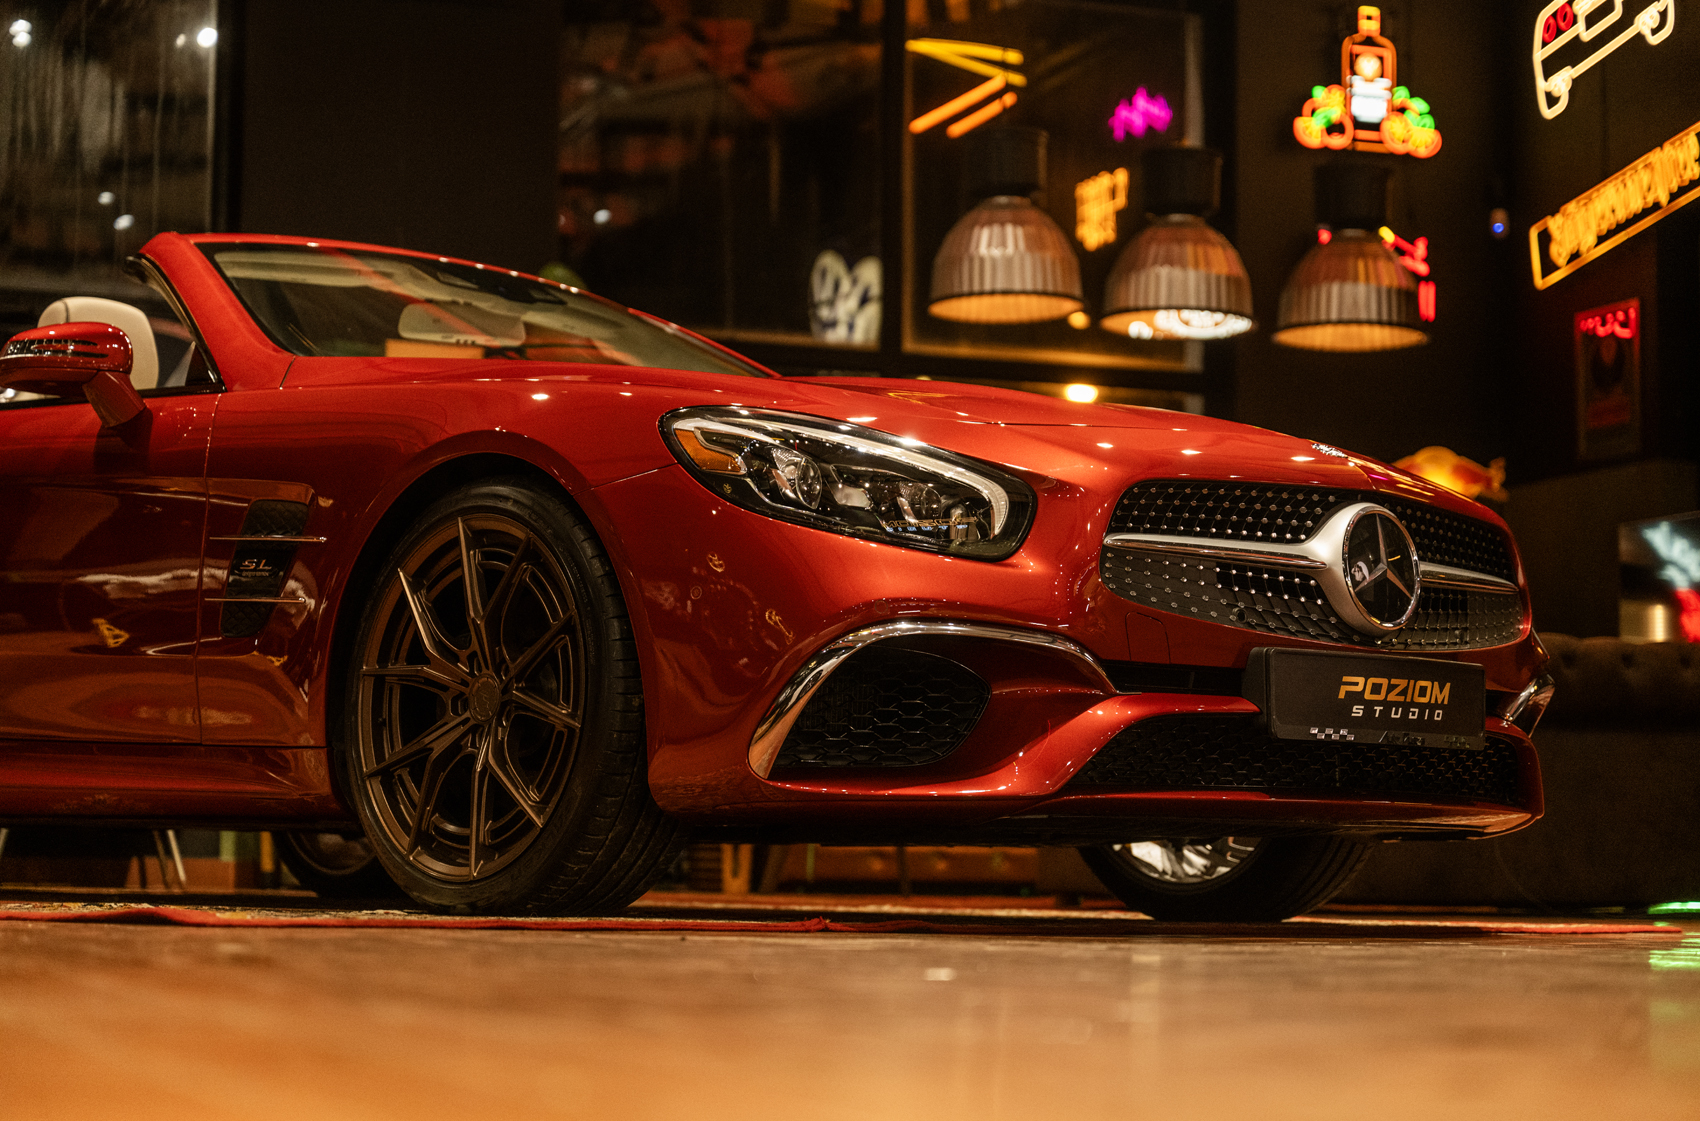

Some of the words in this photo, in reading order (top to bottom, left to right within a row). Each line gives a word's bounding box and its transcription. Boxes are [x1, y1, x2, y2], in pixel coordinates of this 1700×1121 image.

[239, 559, 273, 570] SL
[1338, 676, 1451, 705] POZIOM
[1351, 705, 1443, 721] STUDIO
